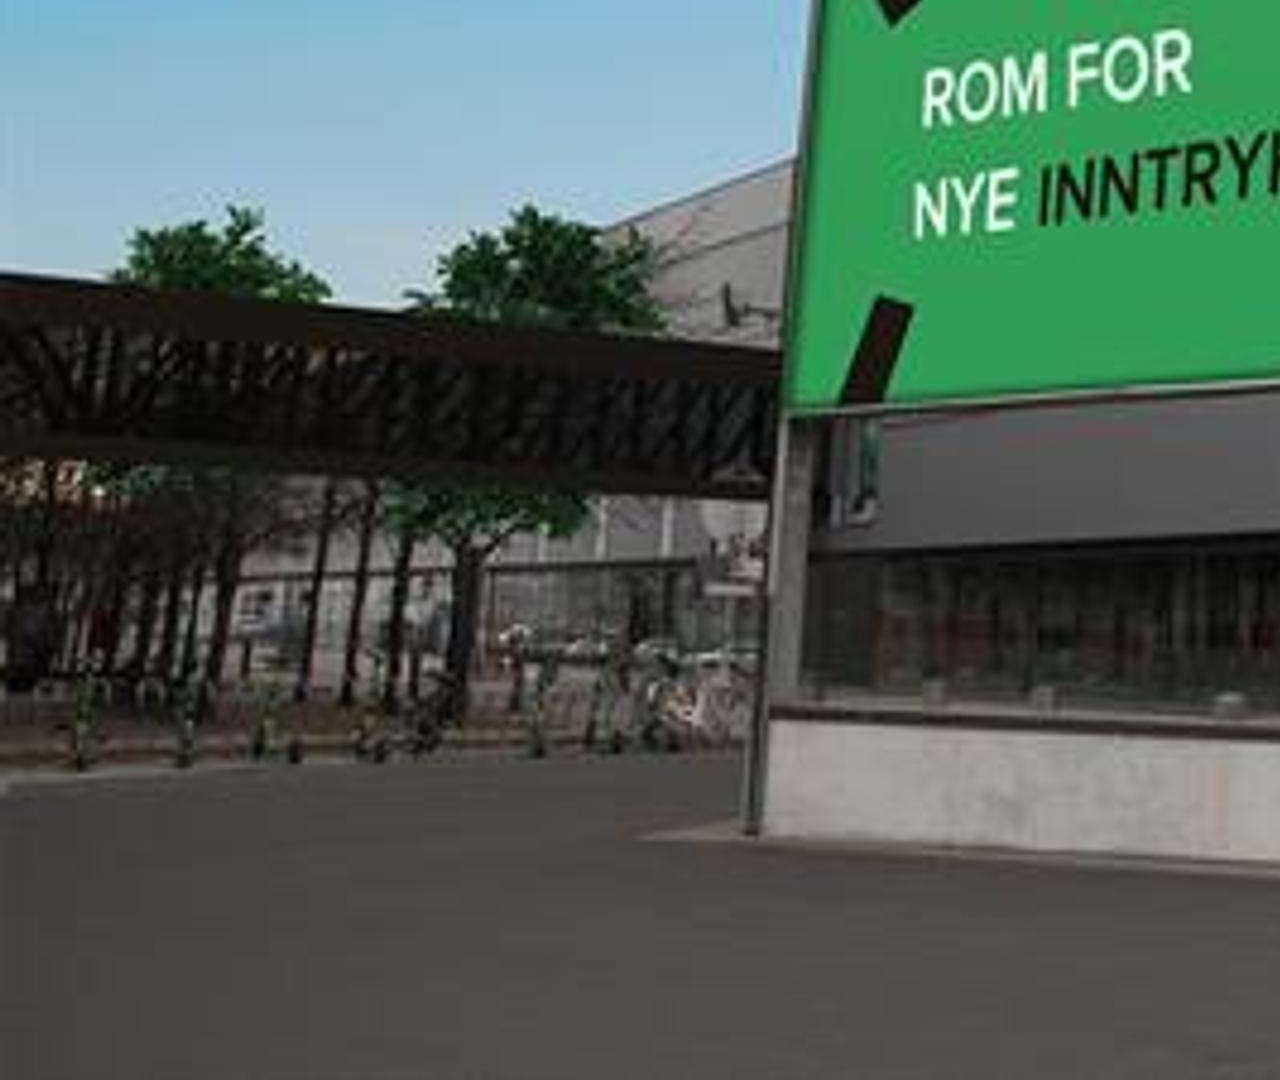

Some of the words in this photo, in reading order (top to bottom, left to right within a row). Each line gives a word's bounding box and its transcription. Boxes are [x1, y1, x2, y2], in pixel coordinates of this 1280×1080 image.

[922, 52, 1048, 127] ROM
[1068, 29, 1191, 107] FOR
[915, 168, 1019, 237] NYE
